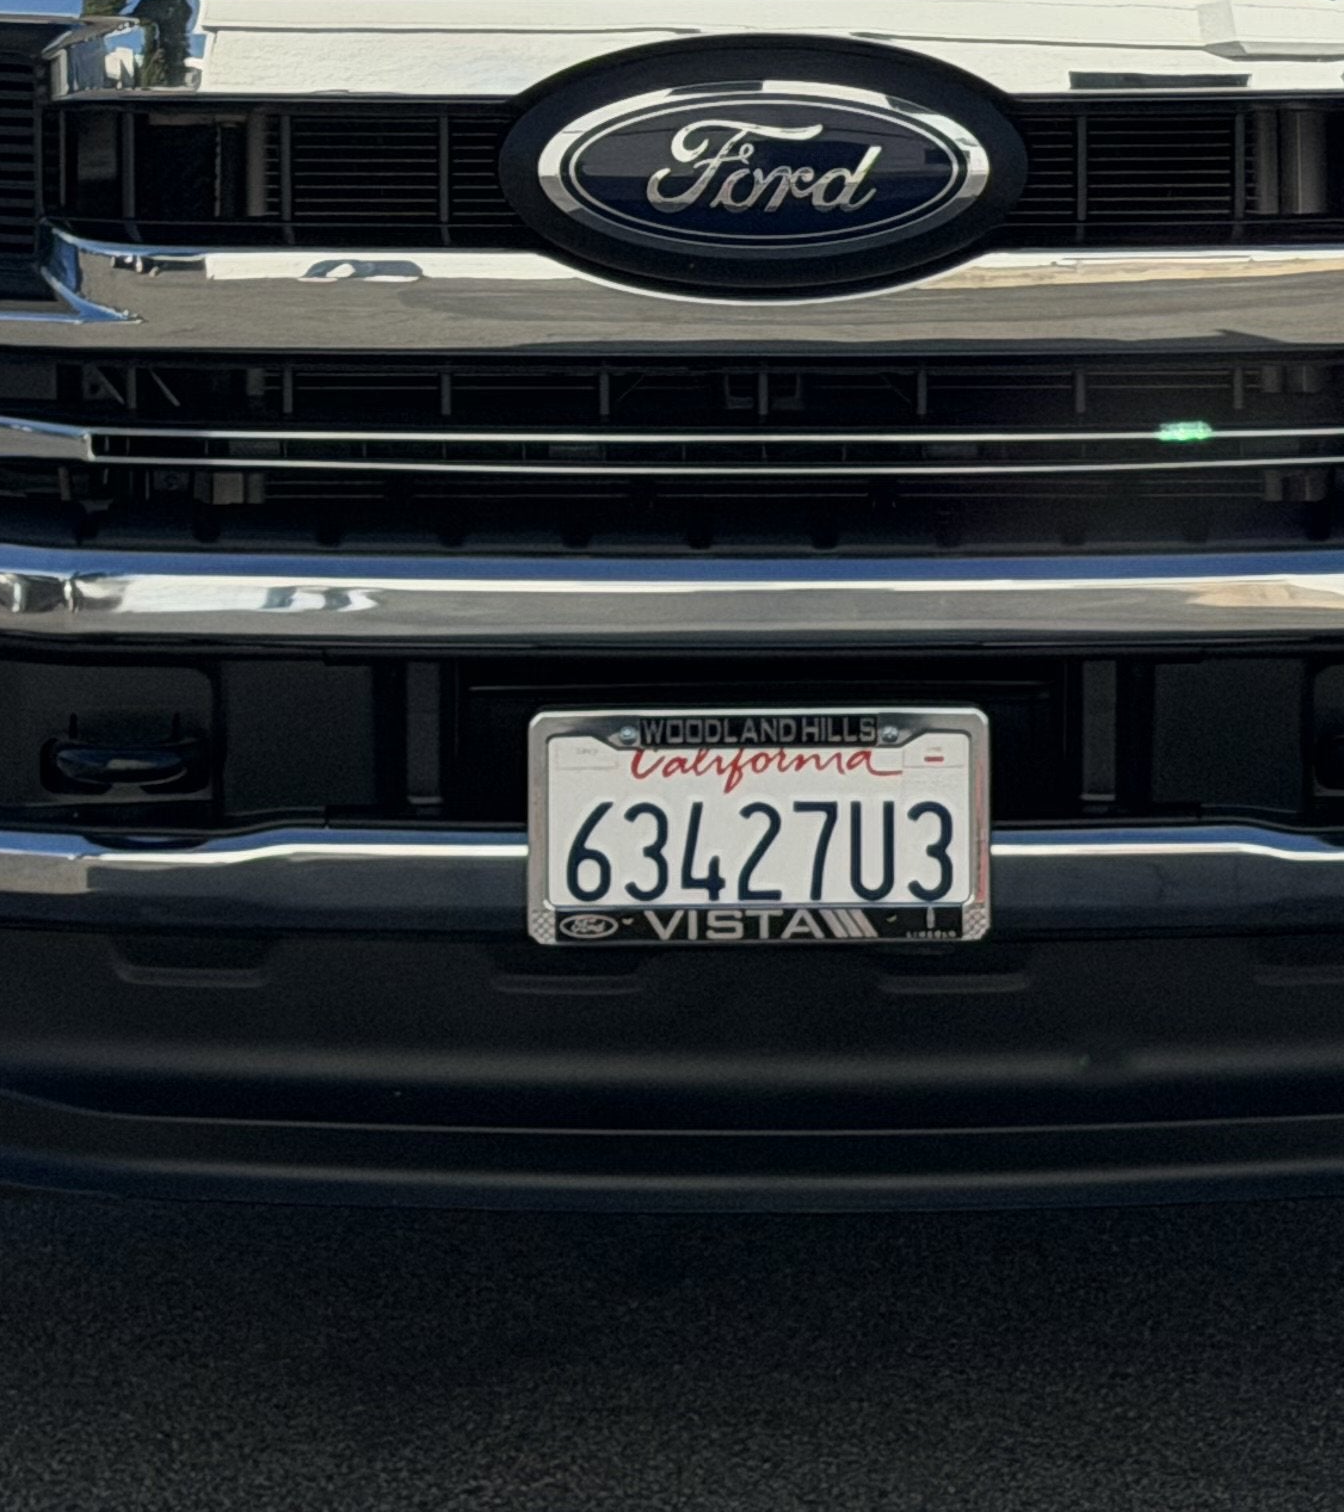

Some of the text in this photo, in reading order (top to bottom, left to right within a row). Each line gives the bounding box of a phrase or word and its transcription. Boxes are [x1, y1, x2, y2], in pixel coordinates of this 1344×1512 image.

[646, 118, 883, 213] Ford
[640, 715, 877, 745] WOODLAND HILLS
[629, 747, 904, 794] California
[565, 800, 955, 902] 63427U3
[643, 910, 821, 941] VISTA
